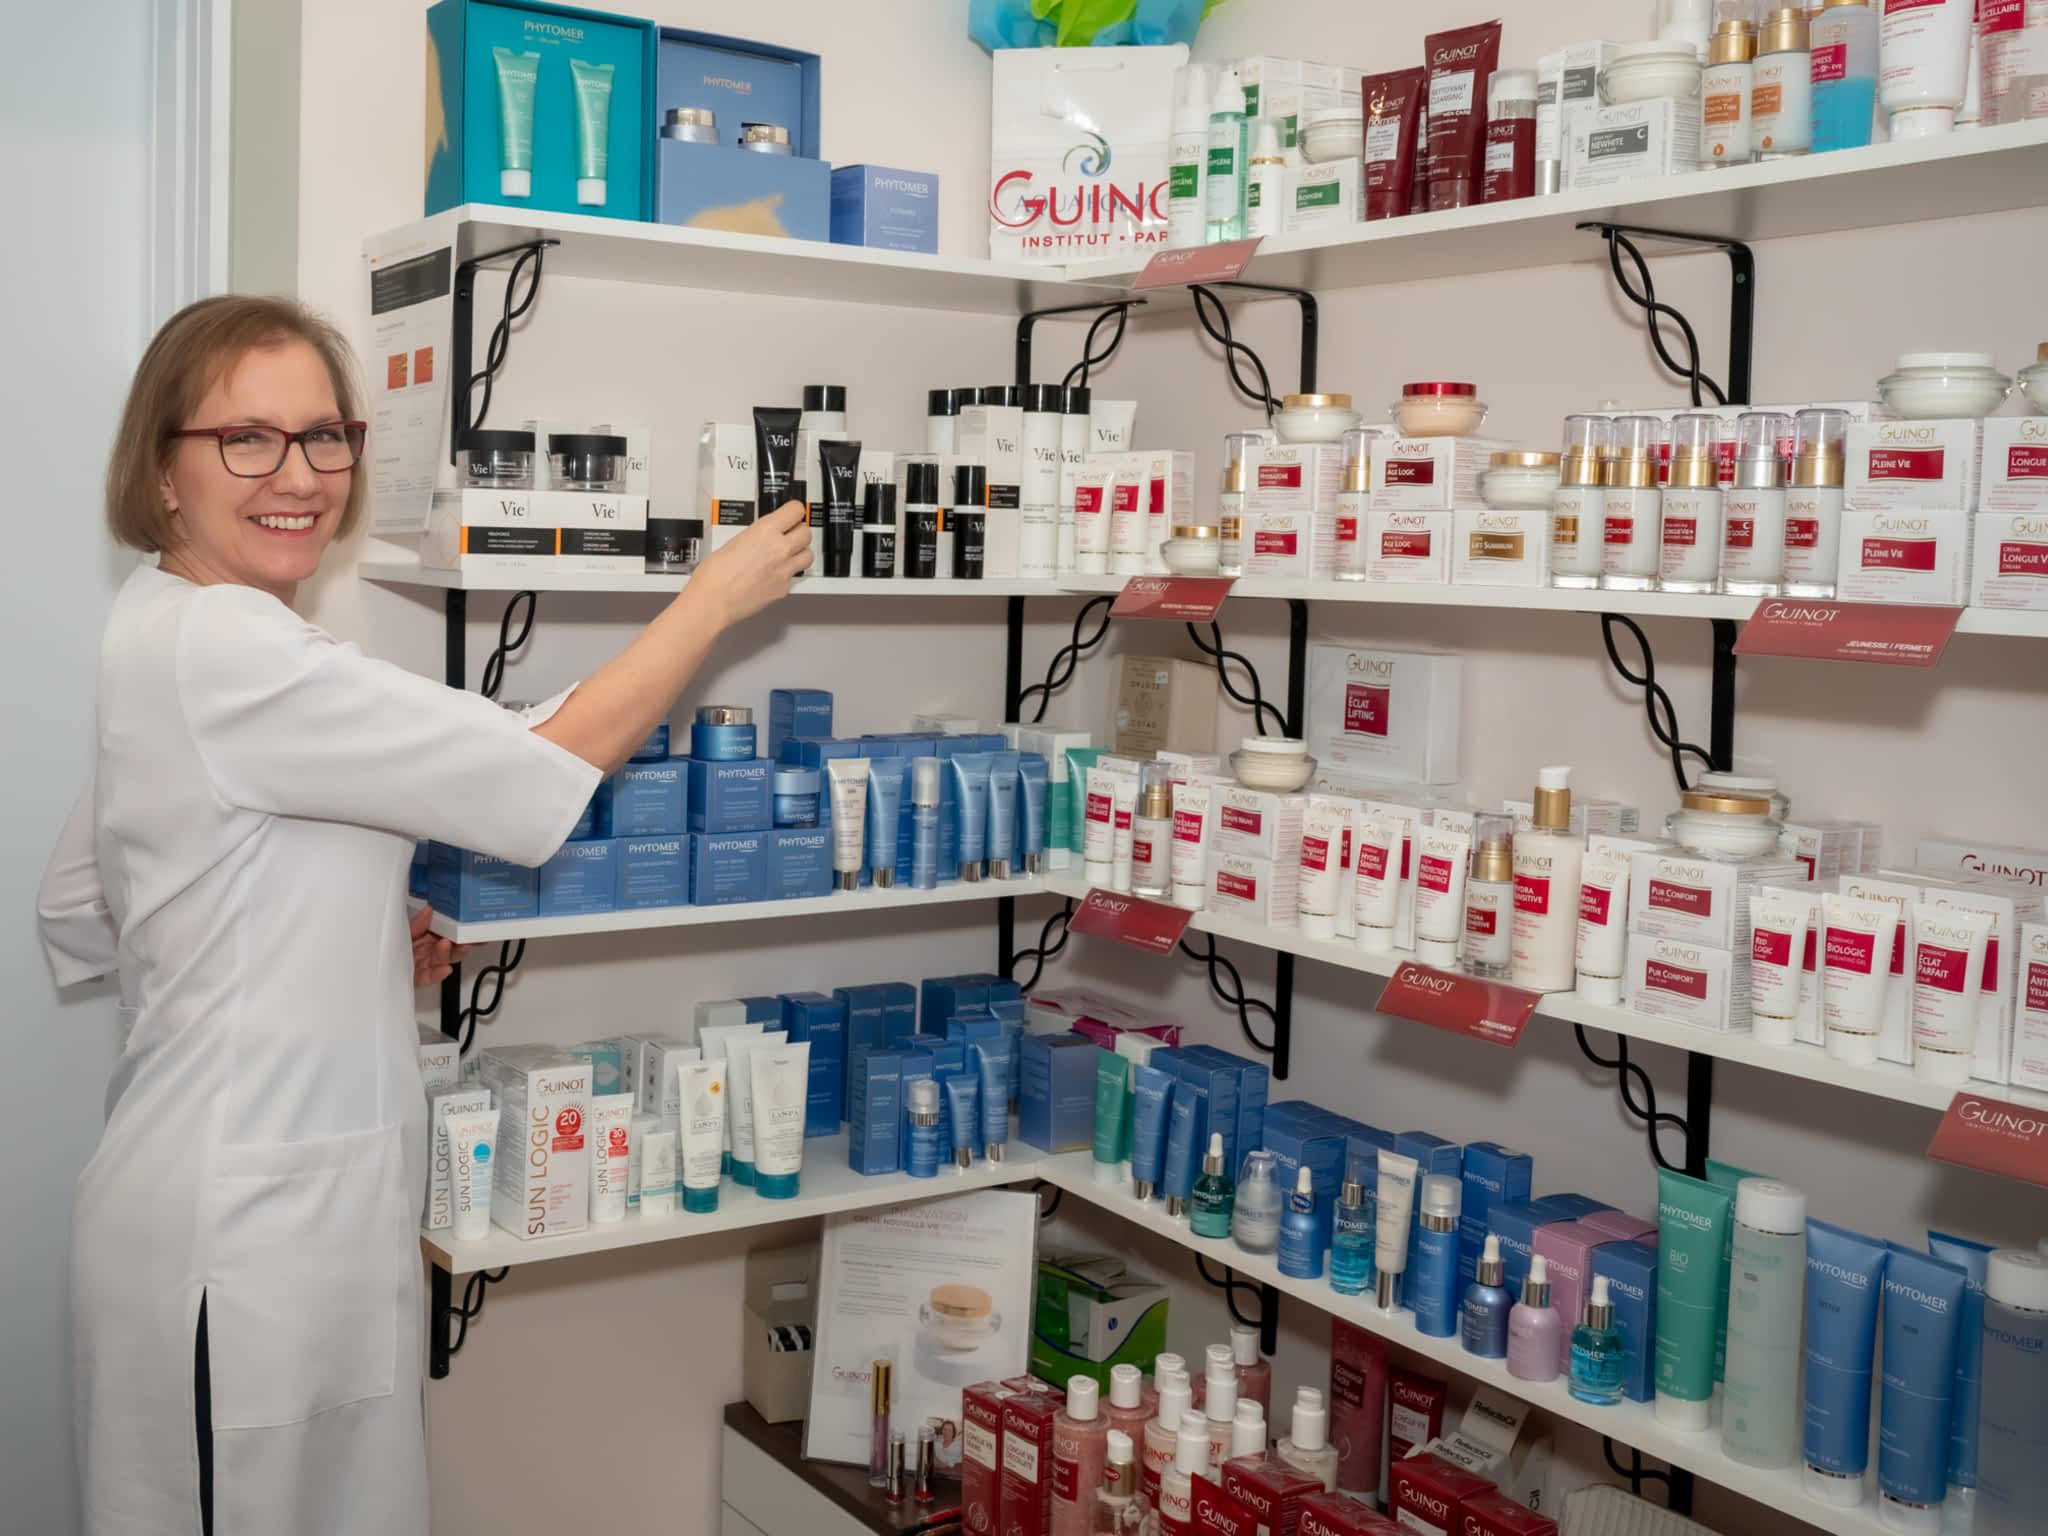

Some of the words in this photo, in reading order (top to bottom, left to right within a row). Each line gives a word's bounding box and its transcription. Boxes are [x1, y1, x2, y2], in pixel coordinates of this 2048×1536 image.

[524, 21, 584, 40] PHYTOMER
[1433, 44, 1479, 63] GUINOT
[703, 76, 752, 91] PHYTOMER
[1591, 137, 1624, 149] NEWHITE
[875, 177, 928, 194] PHYTOMER
[1022, 234, 1110, 248] INSTITUT
[1098, 429, 1120, 442] Vie
[1880, 425, 1936, 440] GUINOT
[771, 435, 790, 446] Vie
[996, 438, 1014, 452] Vie
[1393, 441, 1429, 454] GUINOT
[1034, 448, 1055, 462] Vie
[1060, 450, 1081, 463] Vie
[2011, 458, 2046, 466] LONGUE
[472, 463, 489, 474] Vie
[728, 456, 748, 470] Vie
[1872, 460, 1897, 468] PLEINE
[1898, 459, 1911, 468] VIE
[836, 466, 852, 478] Vie
[500, 501, 525, 516] Vie
[592, 503, 616, 518] Vie
[1388, 513, 1426, 526] GUINOT
[1478, 513, 1518, 528] GUINOT
[1873, 514, 1930, 531] GUINOT
[664, 551, 680, 561] Vie
[1864, 549, 1888, 557] PLEINE
[1890, 549, 1903, 558] VIE
[2003, 553, 2038, 563] LONGUE
[1763, 603, 1841, 622] GUINOT
[1846, 640, 1888, 649] JEUNESSE
[1346, 653, 1394, 674] GUINOT
[1348, 697, 1369, 709] ÉCLAT
[1348, 708, 1374, 720] LIFTING
[625, 770, 677, 780] PHYTOMER
[718, 768, 765, 779] PHYTOMER
[629, 842, 680, 854] PHYTOMER
[709, 840, 758, 851] PHYTOMER
[778, 836, 825, 847] PHYTOMER
[557, 846, 608, 857] HYTOMER
[1515, 856, 1553, 867] UINOT
[1658, 859, 1706, 879] GUINOT
[1651, 886, 1664, 896] PUR
[1666, 889, 1698, 902] CONFORT
[1088, 893, 1131, 912] GUINOT
[1919, 920, 1975, 944] GUINOT
[1755, 936, 1767, 945] RED
[1654, 940, 1702, 961] GUINOT
[1754, 943, 1773, 955] LOGIC
[1827, 944, 1865, 958] BIOLOGIC
[1919, 955, 1941, 968] ÉCLAT
[1648, 967, 1661, 977] PUR
[1663, 969, 1694, 984] CONFORT
[1918, 965, 1949, 978] PARFAIT
[1400, 967, 1456, 992] GUINOT
[537, 1078, 585, 1093] GUINOT
[561, 1111, 577, 1125] 20
[593, 1107, 629, 1120] GUINOT
[1960, 1101, 2048, 1136] GUINOT
[531, 1104, 550, 1178] LOGIC
[597, 1127, 607, 1166] LOGIC
[458, 1142, 471, 1183] LOGIC
[599, 1168, 608, 1194] SUN
[1464, 1171, 1500, 1191] PHYTOMER
[434, 1187, 448, 1225] SUN
[461, 1186, 471, 1212] SUN
[528, 1187, 545, 1235] SUN
[1660, 1203, 1712, 1229] PHYTOMER
[1670, 1249, 1688, 1265] BIO
[1808, 1258, 1869, 1287] PHYTOMER
[1885, 1279, 1948, 1311] PHYTOMER
[1394, 1382, 1435, 1408] GUINOT
[1004, 1408, 1039, 1439] GUINOT
[1226, 1477, 1271, 1513] GUINOT
[1399, 1479, 1449, 1520] GUINOT
[1197, 1499, 1238, 1535] GUINOT
